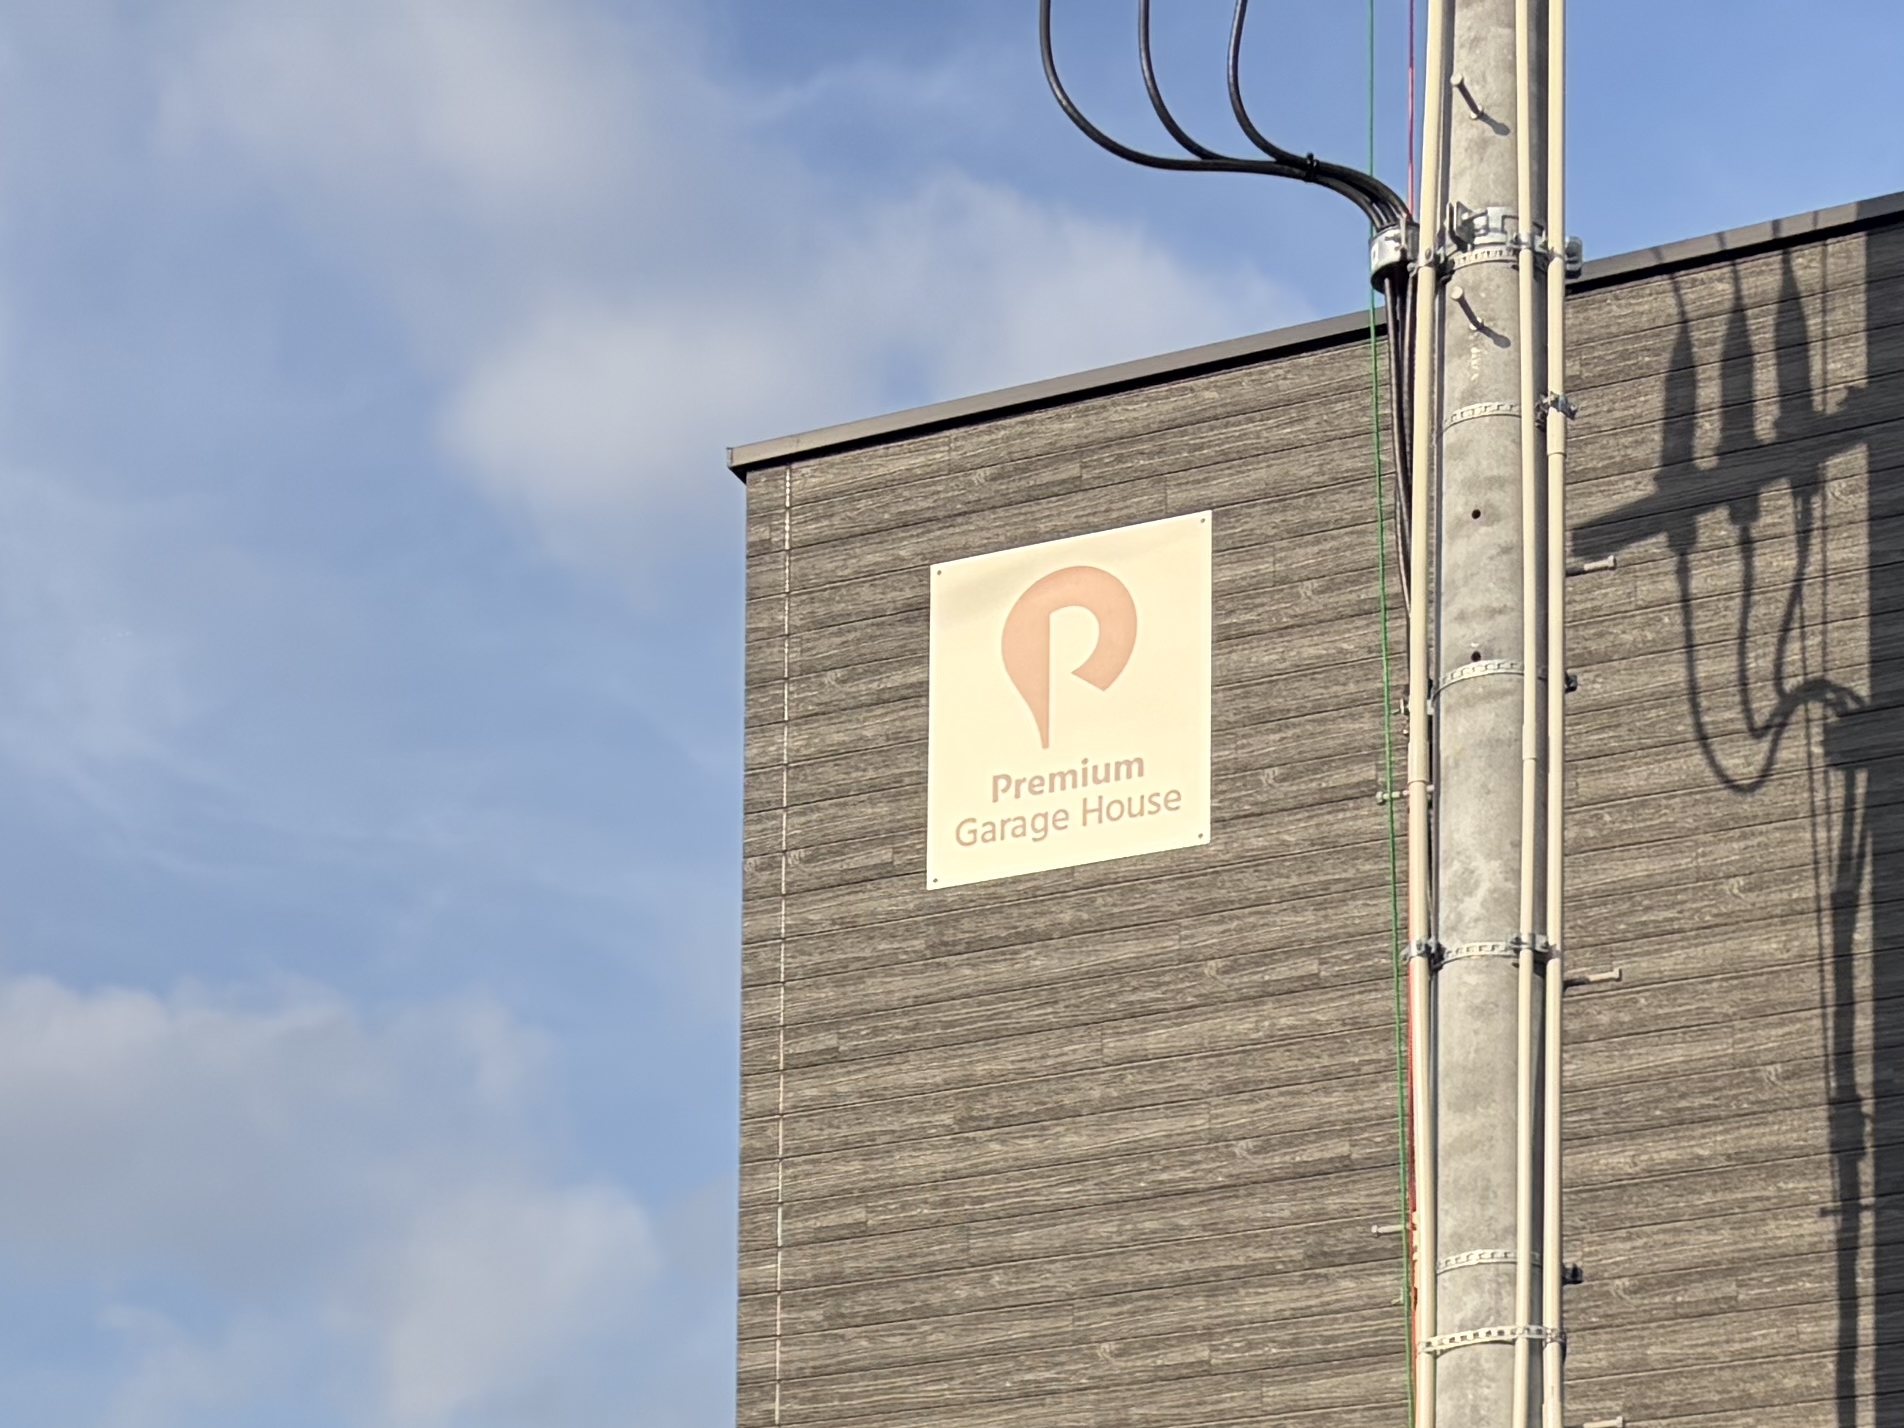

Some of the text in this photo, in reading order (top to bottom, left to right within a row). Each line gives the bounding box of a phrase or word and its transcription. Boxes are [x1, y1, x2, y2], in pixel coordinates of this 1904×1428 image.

[991, 756, 1145, 803] Premium
[955, 788, 1182, 847] Garage House
